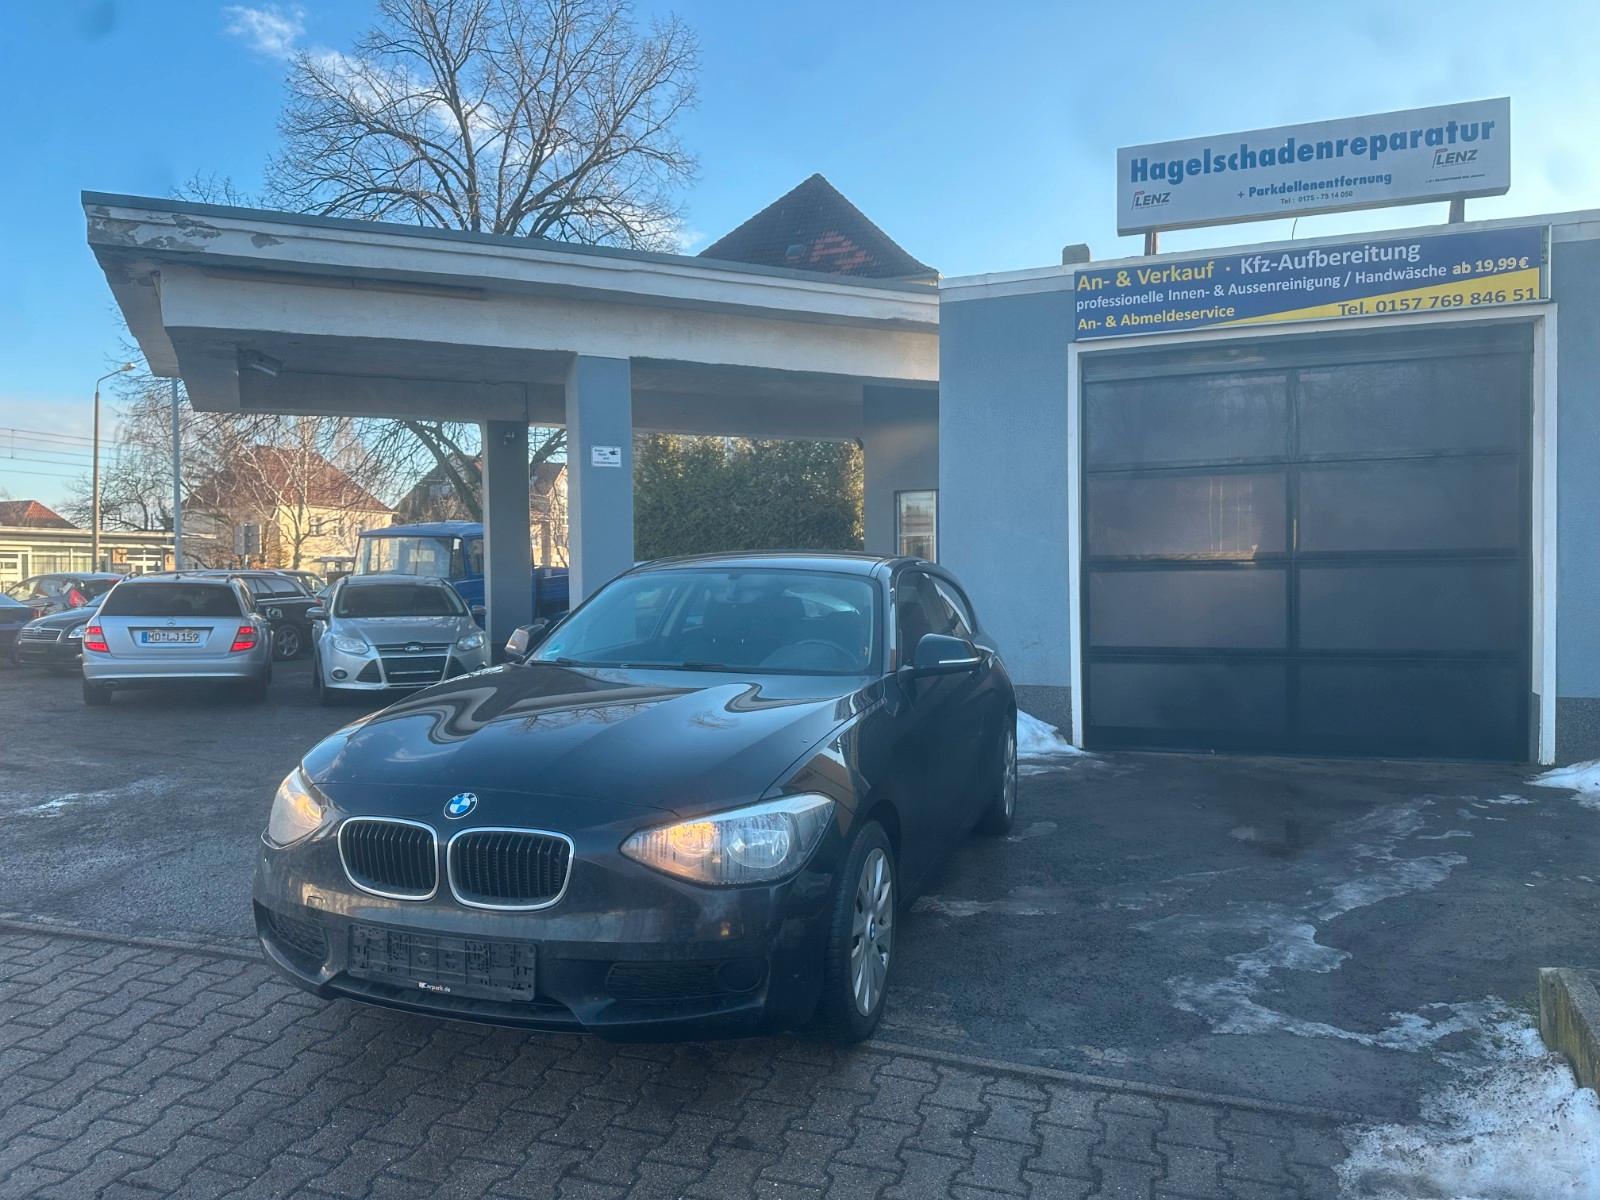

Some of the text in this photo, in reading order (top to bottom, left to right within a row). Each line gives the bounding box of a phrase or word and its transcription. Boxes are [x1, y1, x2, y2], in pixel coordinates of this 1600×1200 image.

[1131, 120, 1495, 185] Hagelschadenreparatur
[1436, 149, 1478, 165] LENZ
[1135, 191, 1171, 206] LENZ
[1249, 173, 1392, 197] Parkdellenentfernung
[1240, 244, 1420, 275] Kfz-Aufbereitung
[1076, 291, 1164, 312] professionelle
[1168, 286, 1210, 301] Innen-
[1213, 284, 1225, 297] &
[1228, 276, 1341, 296] Aussenreinigung
[1355, 264, 1447, 284] Handwäsche
[1452, 261, 1471, 275] ab
[1077, 261, 1214, 291] An- & Verkauf
[1338, 287, 1537, 316] Tel. 0157 769 846 51
[1078, 305, 1235, 331] An- & Abmeldeservice
[182, 631, 199, 641] 159
